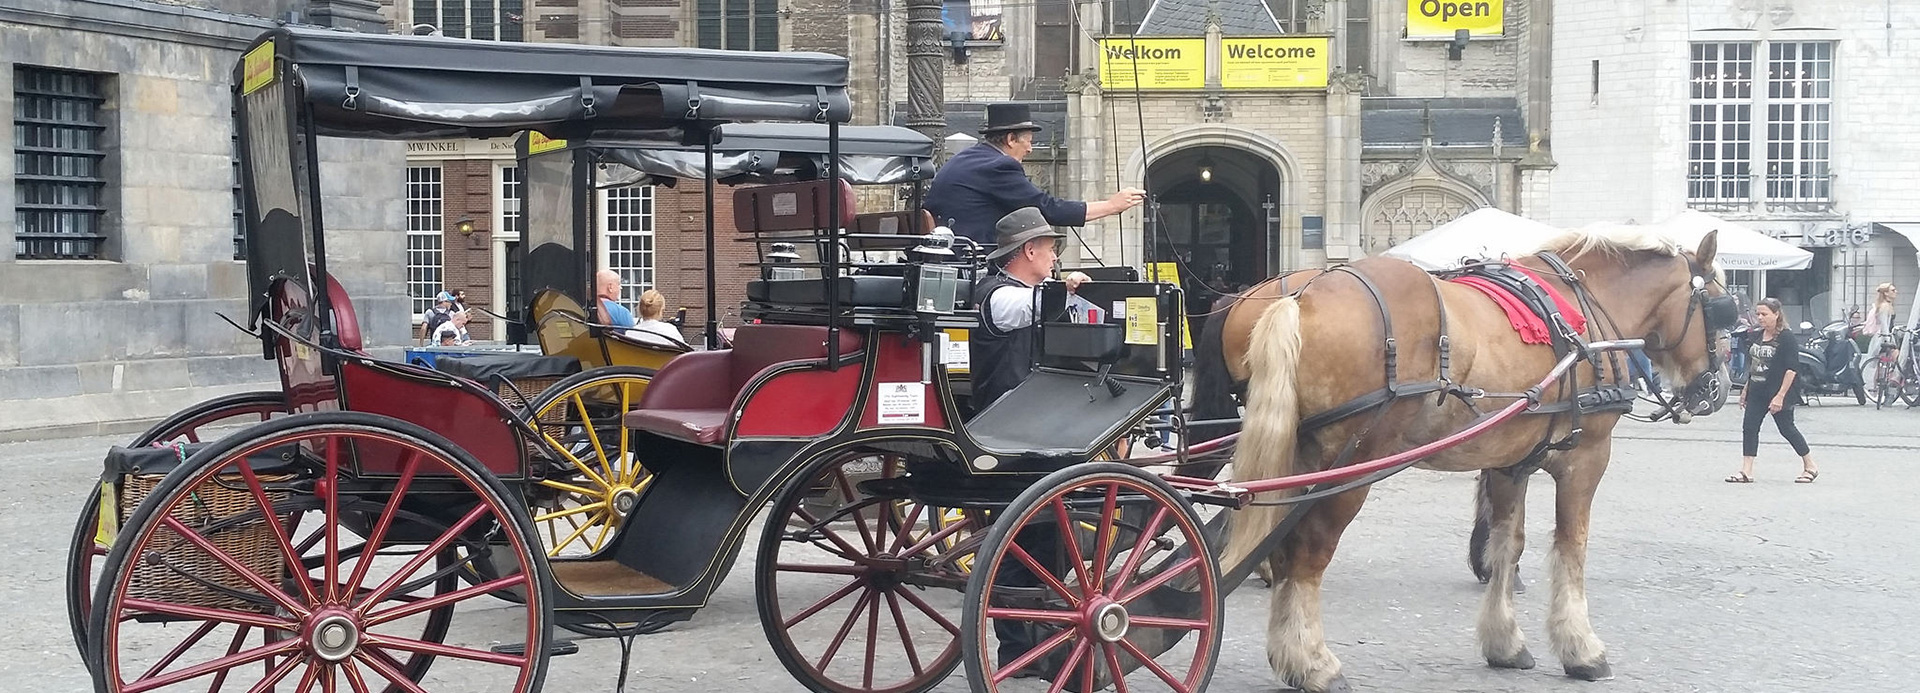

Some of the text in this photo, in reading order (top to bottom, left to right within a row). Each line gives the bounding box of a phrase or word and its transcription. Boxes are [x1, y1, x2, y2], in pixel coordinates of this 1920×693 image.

[1420, 0, 1489, 22] Open
[1107, 45, 1181, 59] Welkom
[1227, 44, 1316, 58] Welcome
[407, 142, 459, 152] MWINKEL
[1721, 257, 1755, 266] Nieuwe
